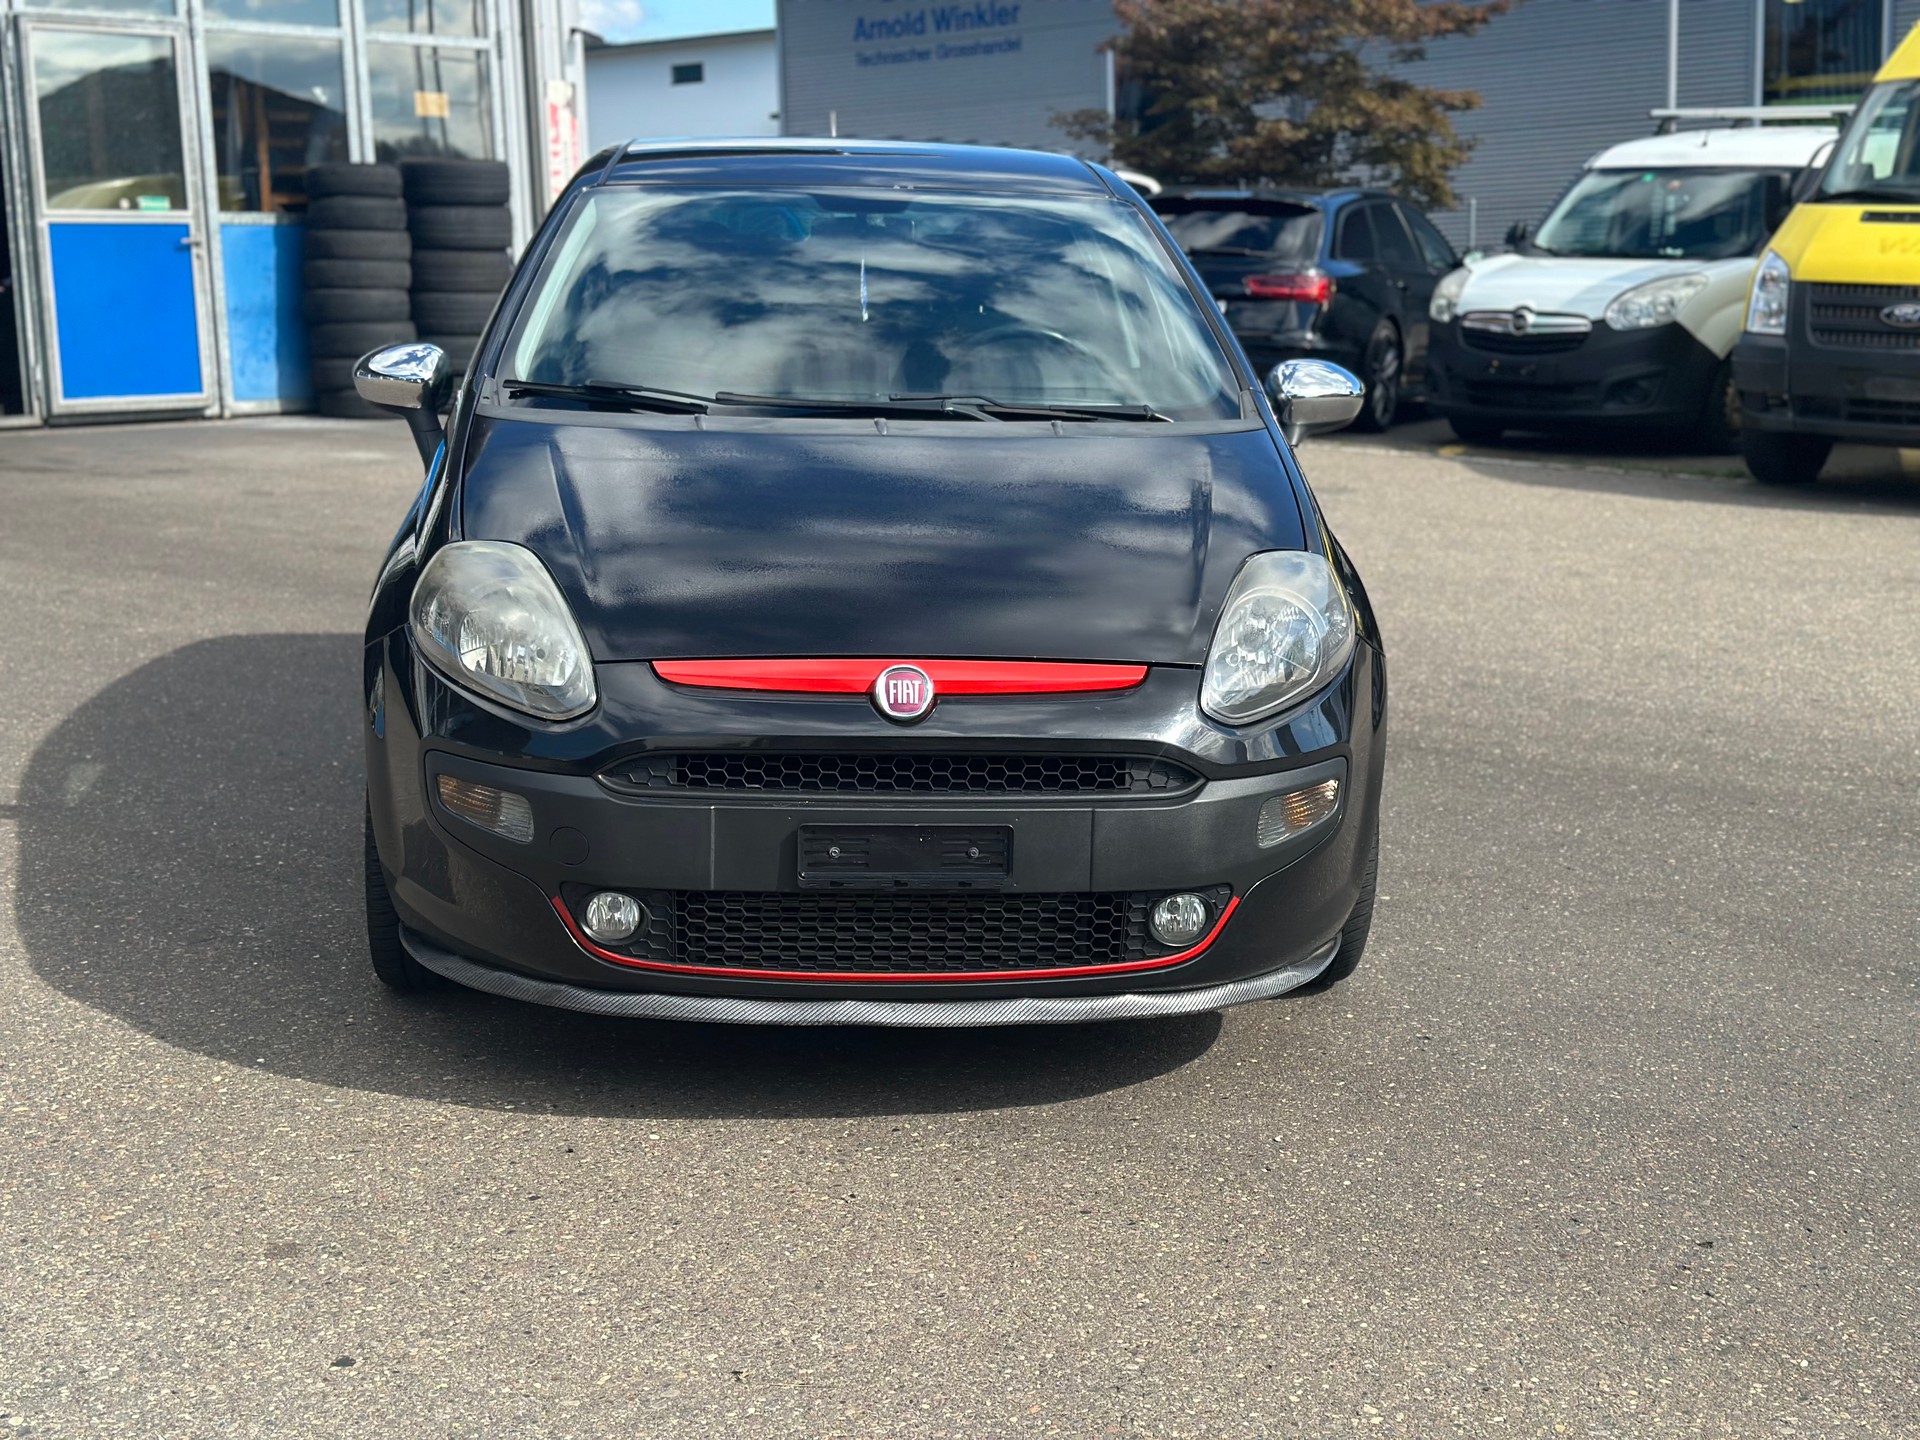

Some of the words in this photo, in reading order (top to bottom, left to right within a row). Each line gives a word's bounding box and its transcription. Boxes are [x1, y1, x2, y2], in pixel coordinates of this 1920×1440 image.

[853, 9, 926, 41] Arnold
[931, 1, 1021, 32] Winkler
[889, 680, 921, 704] FIAT
